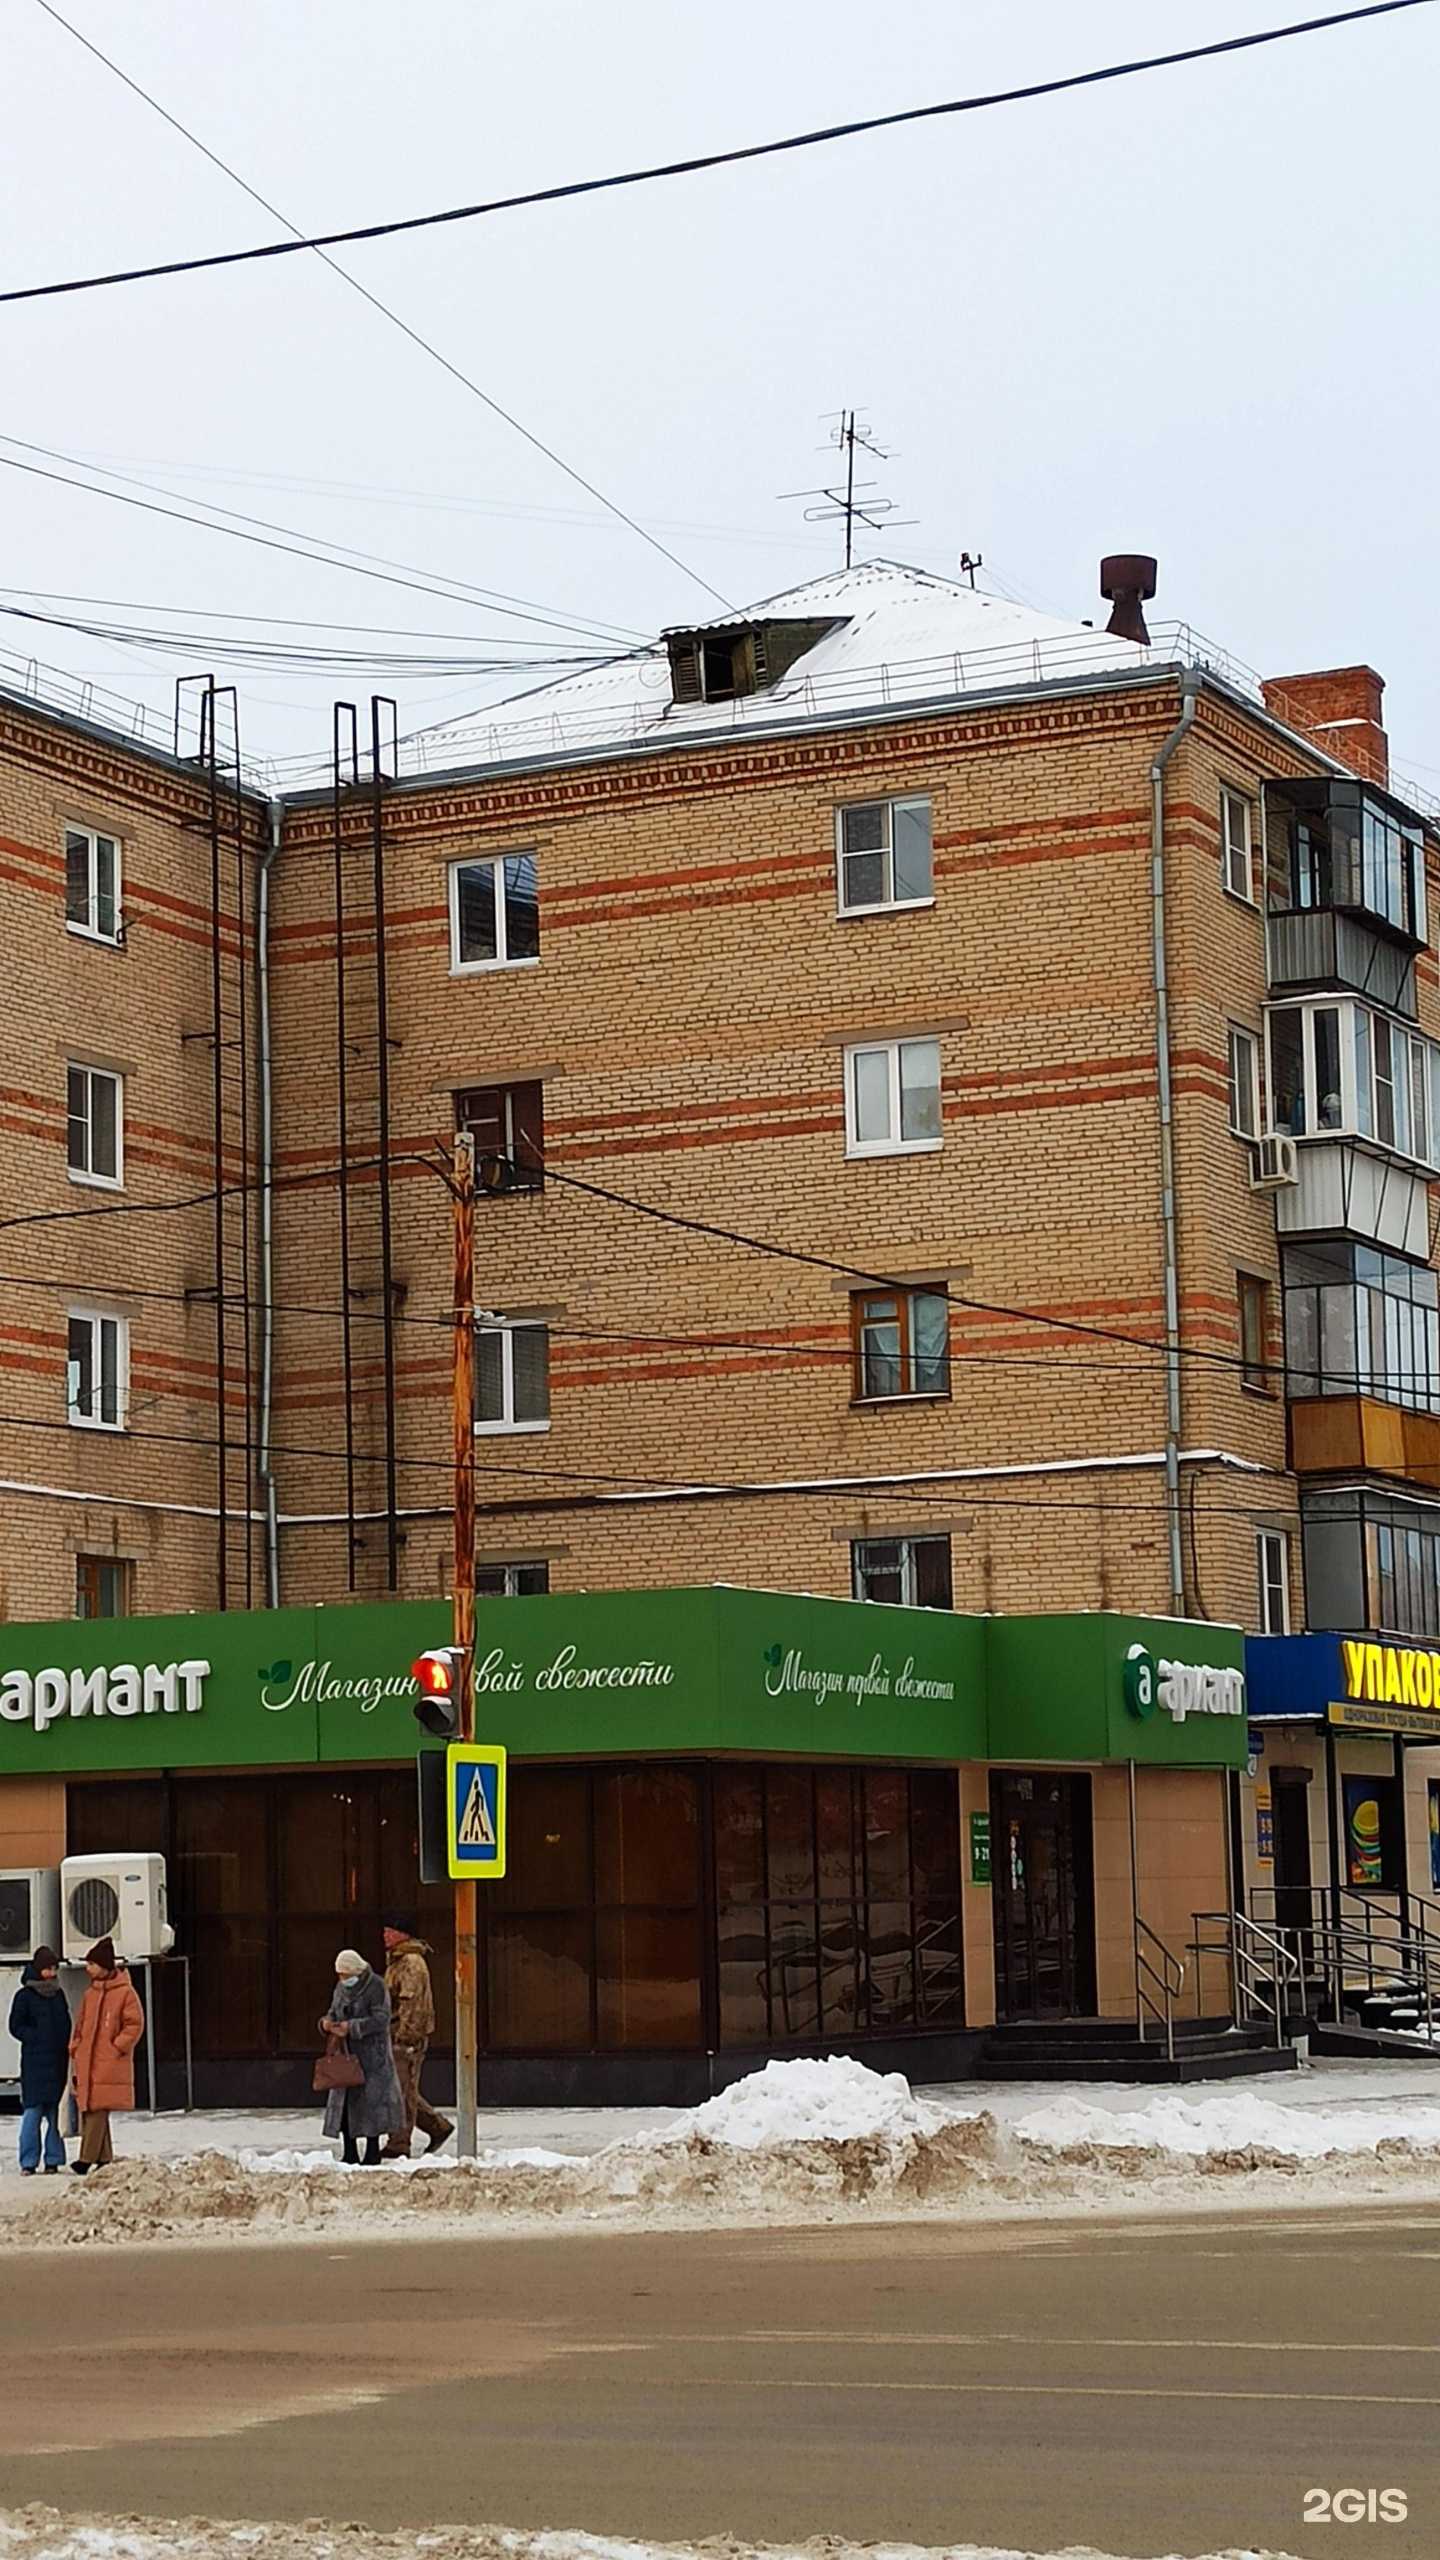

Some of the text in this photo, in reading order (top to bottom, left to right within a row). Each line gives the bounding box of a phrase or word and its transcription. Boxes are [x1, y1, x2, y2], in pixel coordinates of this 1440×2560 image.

[0, 1660, 211, 1732] ариант
[261, 1660, 418, 1713] Магазин
[535, 1645, 674, 1690] свежести
[765, 1649, 955, 1706] Магазин первой свежести
